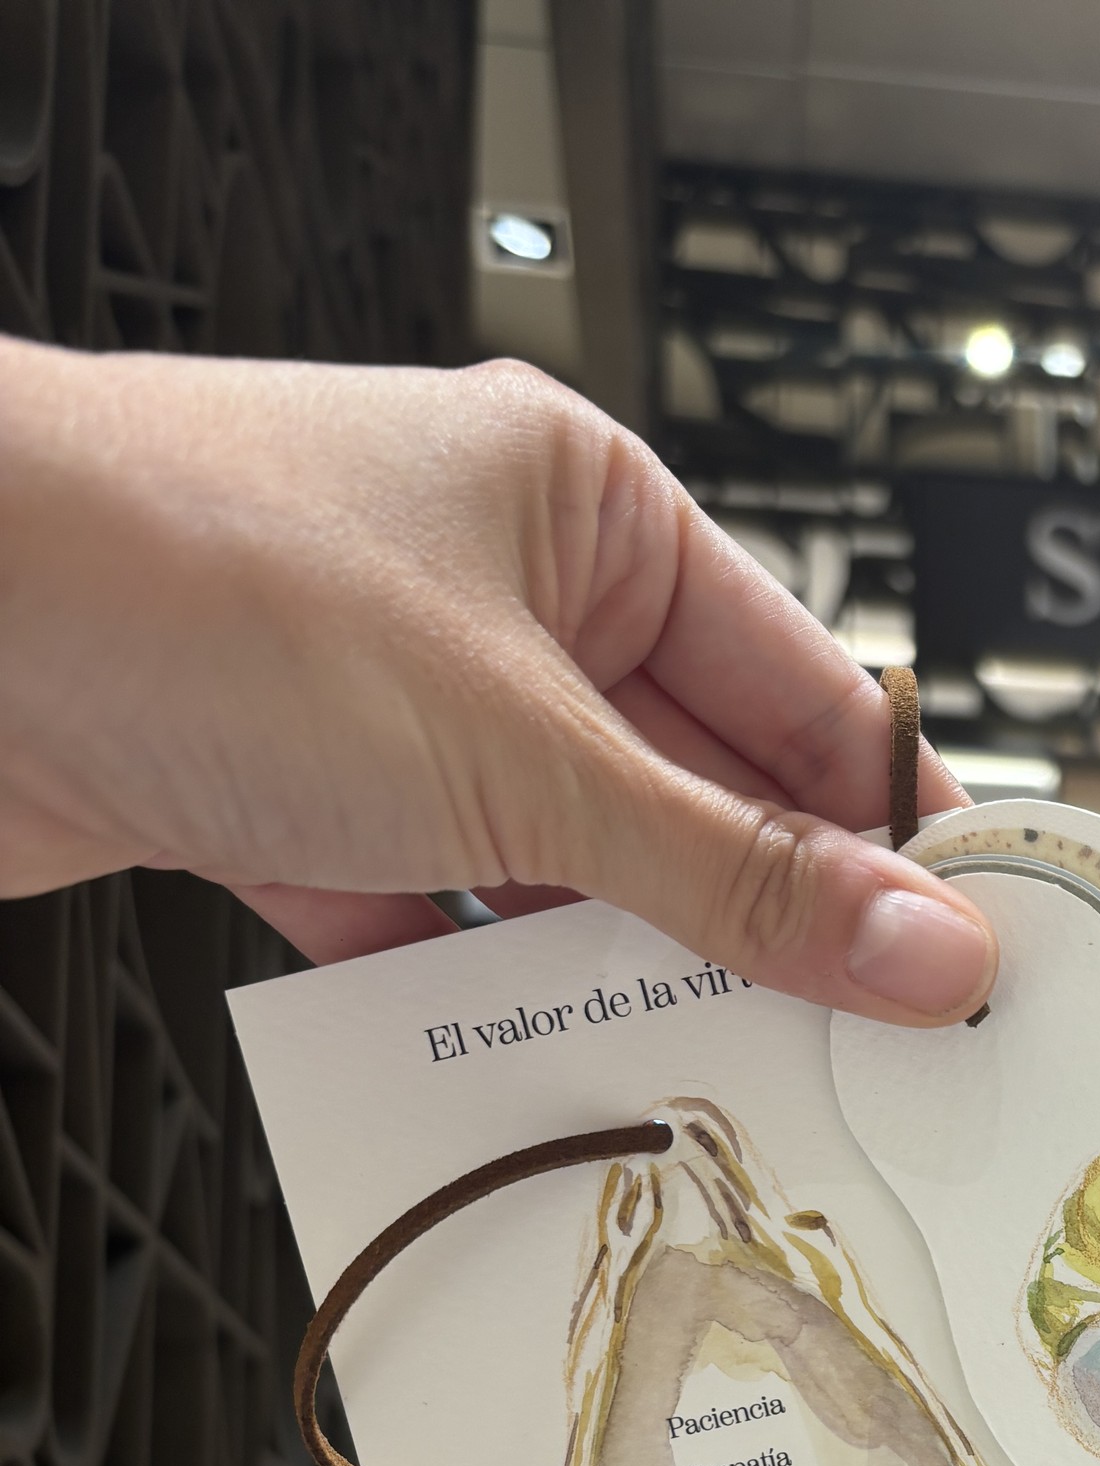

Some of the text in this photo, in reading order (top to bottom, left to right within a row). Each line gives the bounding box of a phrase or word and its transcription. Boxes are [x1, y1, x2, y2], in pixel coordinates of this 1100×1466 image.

[423, 961, 753, 1063] El valor de la vir
[665, 1396, 786, 1439] Paciencia
